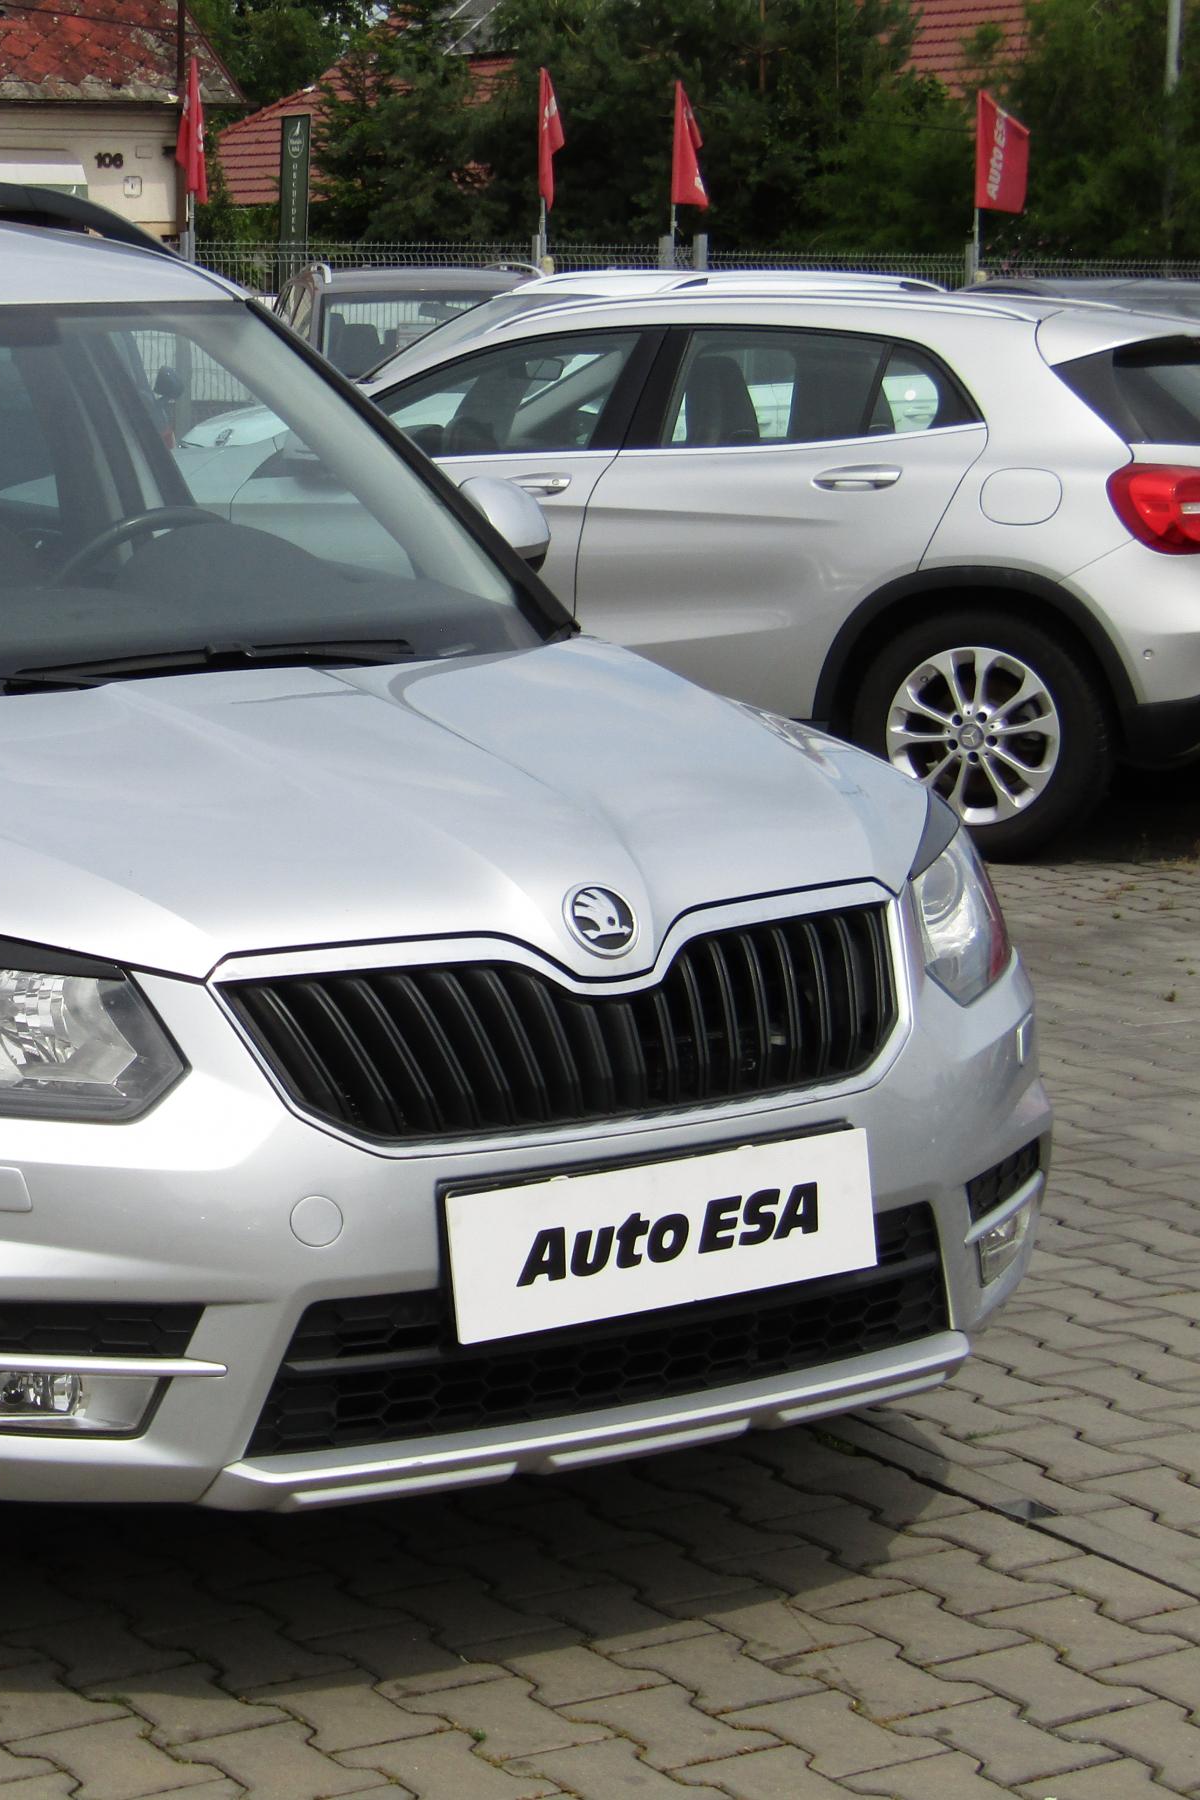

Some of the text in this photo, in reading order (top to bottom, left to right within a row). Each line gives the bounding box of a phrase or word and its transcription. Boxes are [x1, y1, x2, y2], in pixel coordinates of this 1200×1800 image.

[94, 152, 124, 169] 106
[516, 1181, 819, 1287] Auto ESA
